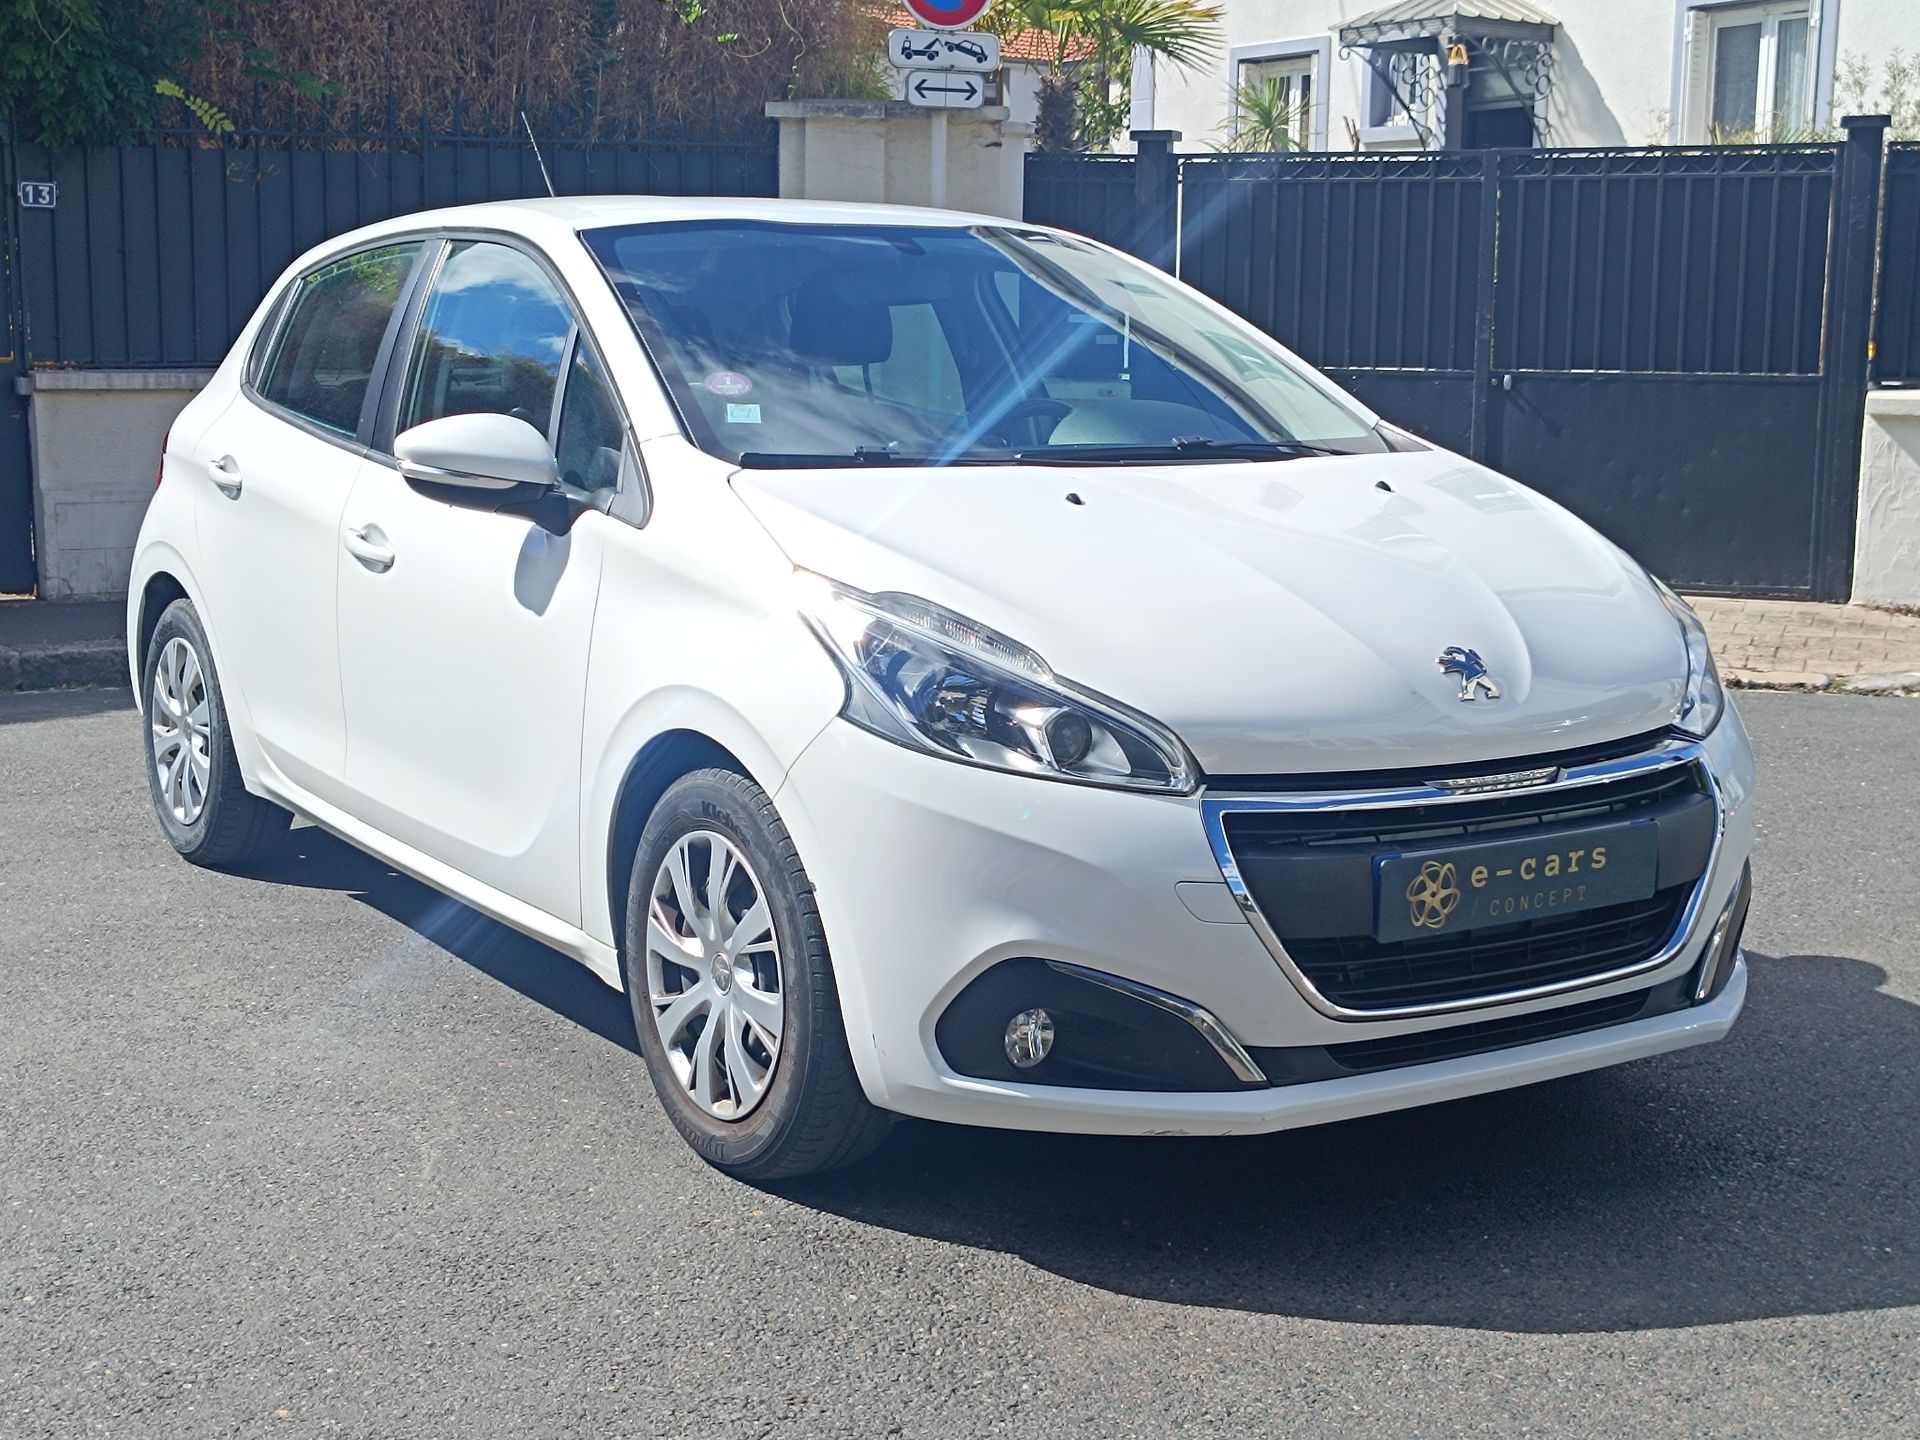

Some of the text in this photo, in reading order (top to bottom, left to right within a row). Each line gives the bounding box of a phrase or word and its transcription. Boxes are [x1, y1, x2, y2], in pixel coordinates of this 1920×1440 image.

[25, 185, 50, 204] 13
[1470, 846, 1607, 888] e-cars
[1489, 885, 1588, 916] CONCEPT
